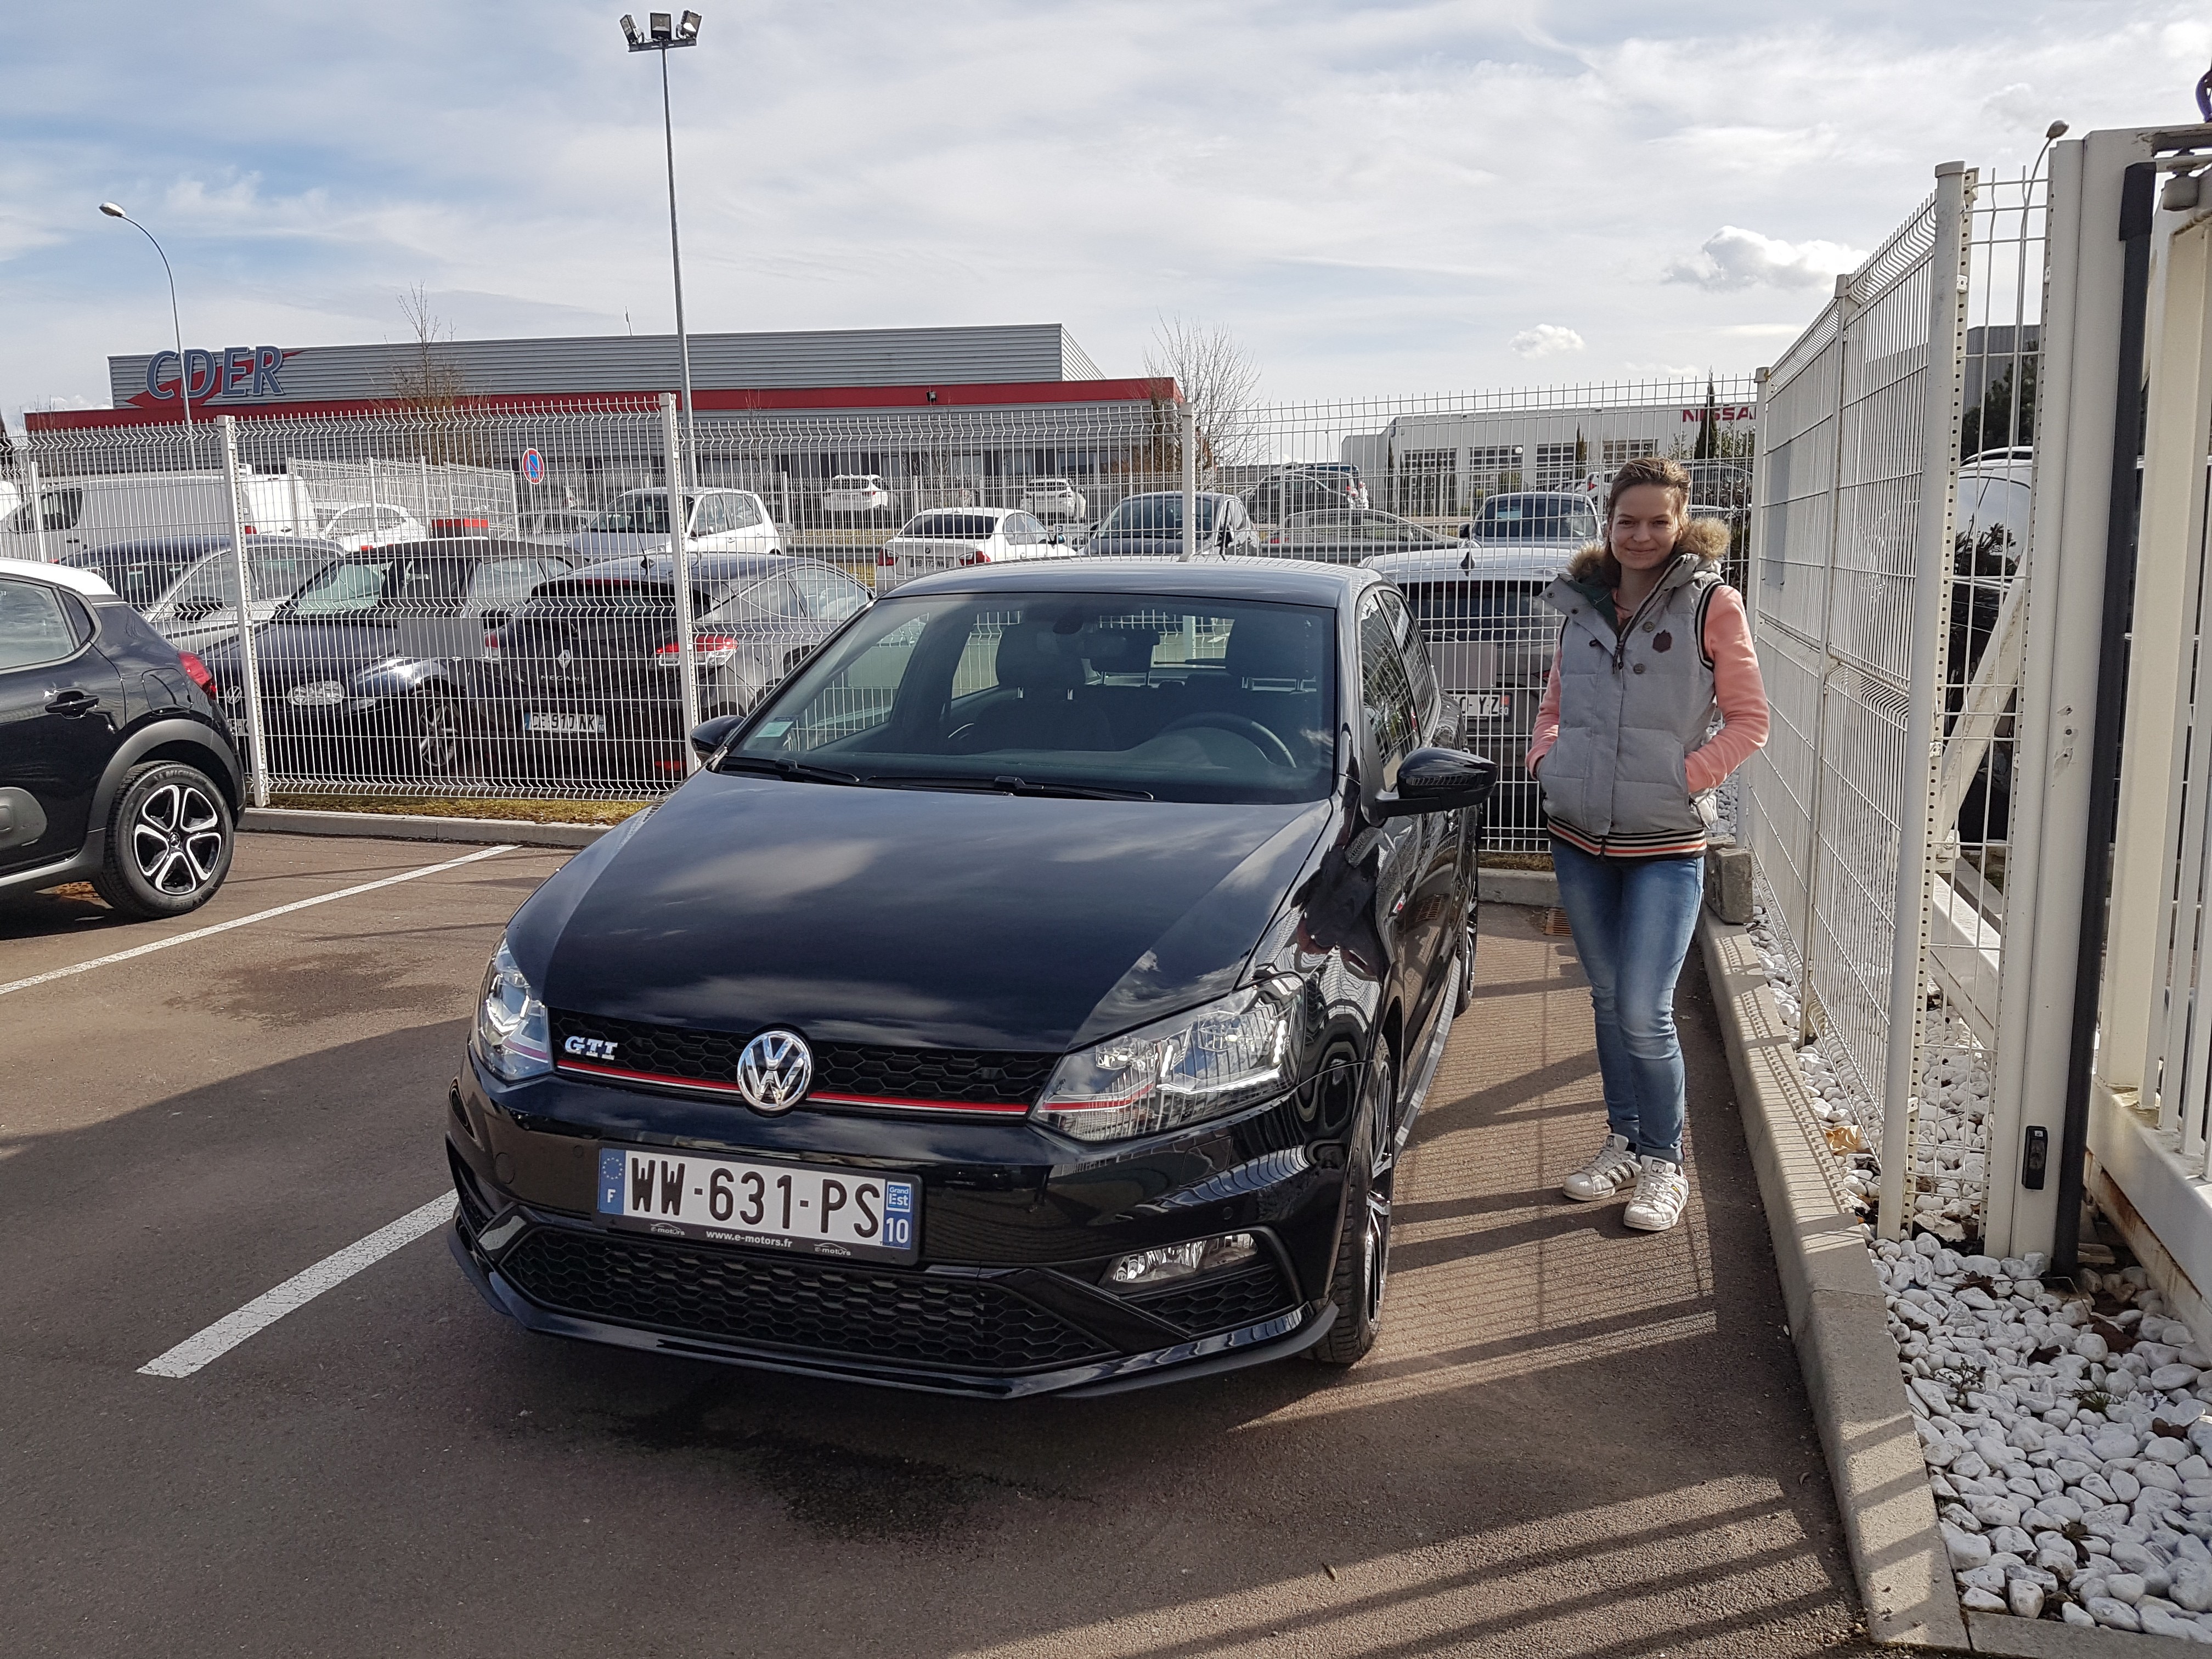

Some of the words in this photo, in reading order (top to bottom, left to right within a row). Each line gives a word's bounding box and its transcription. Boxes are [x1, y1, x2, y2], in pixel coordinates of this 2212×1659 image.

[146, 346, 284, 399] CDER
[1683, 407, 1756, 422] NISSA
[565, 1036, 618, 1060] GTI
[607, 1189, 616, 1203] F
[631, 1157, 881, 1238] WW-631-PS
[889, 1193, 909, 1206] Est
[706, 1231, 793, 1248] www.e-motors.fr
[886, 1217, 909, 1244] 10
